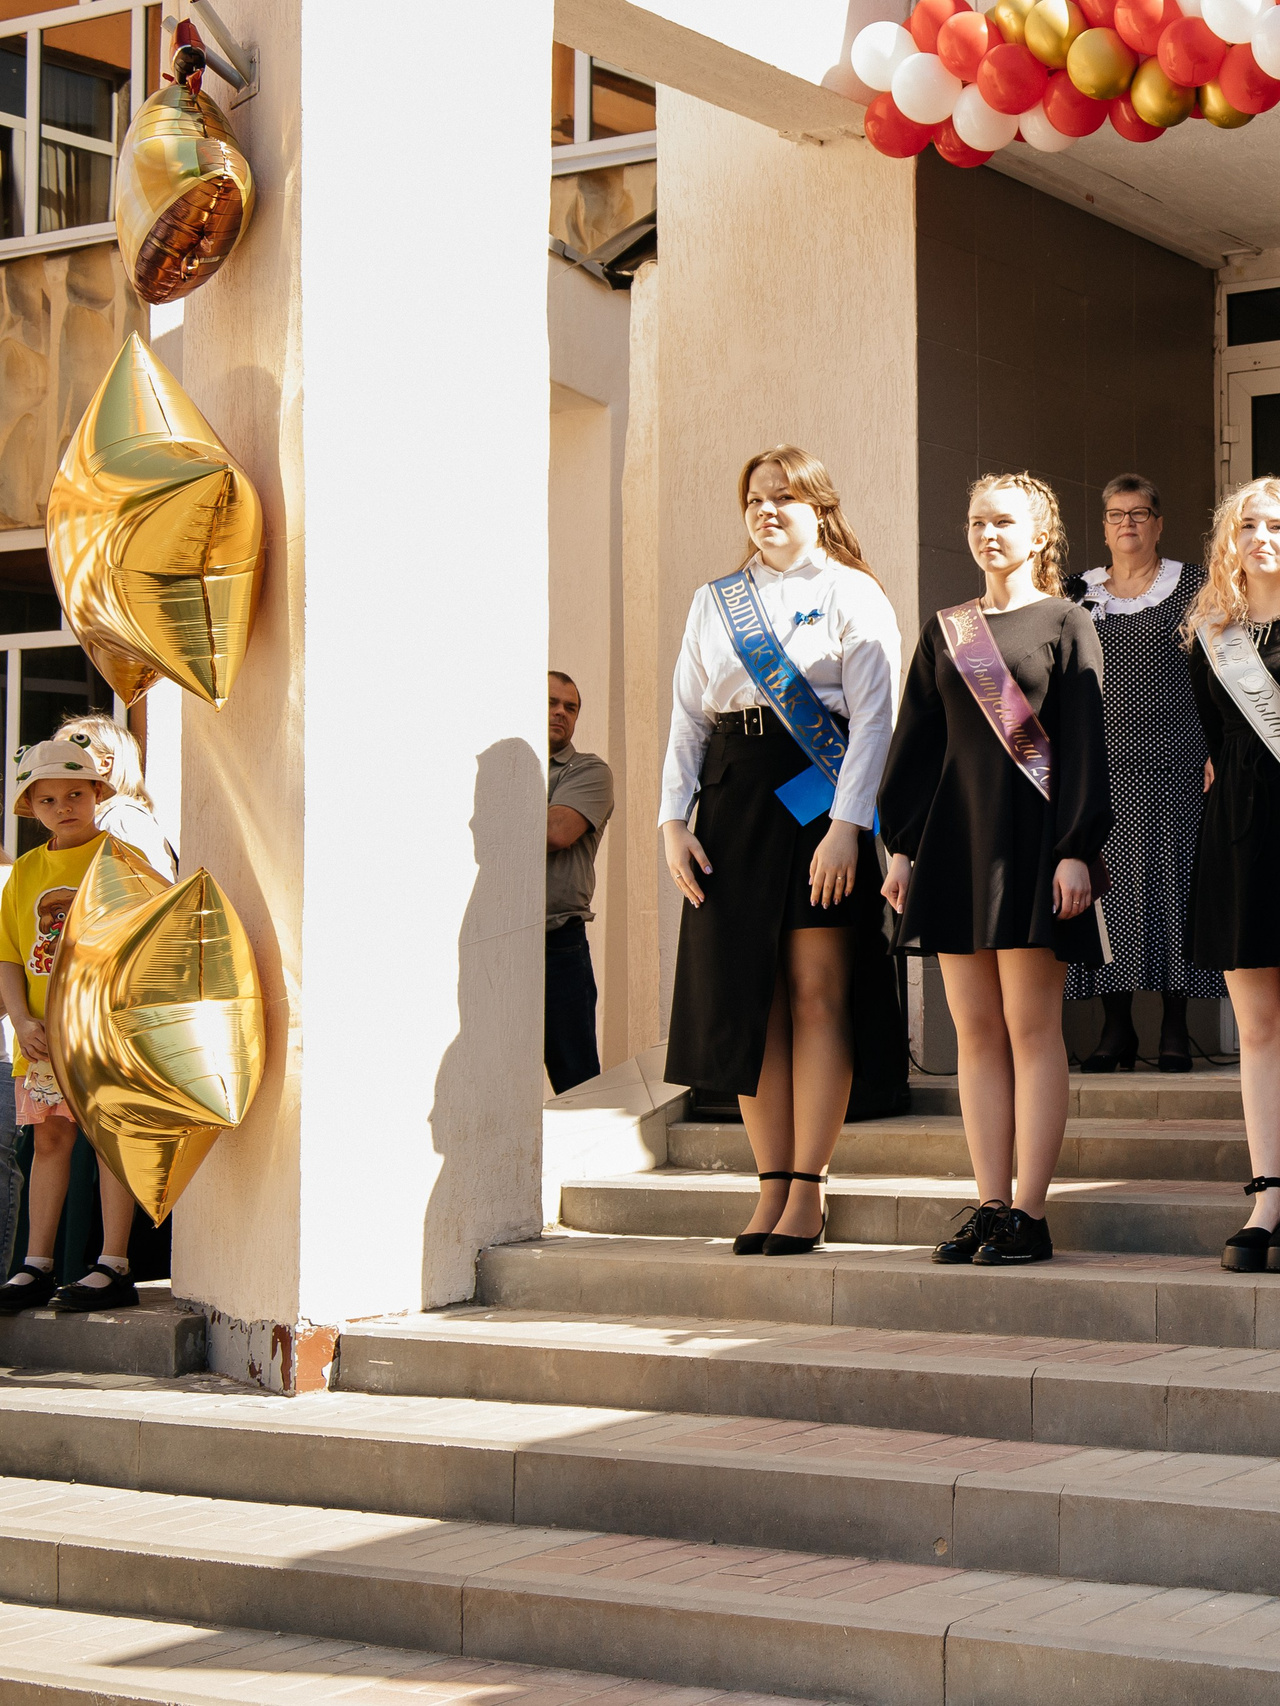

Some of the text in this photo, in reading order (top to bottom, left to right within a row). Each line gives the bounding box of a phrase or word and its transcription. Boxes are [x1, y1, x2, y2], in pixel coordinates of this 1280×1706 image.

[721, 579, 845, 778] ВЫПУСКНИК 202
[963, 641, 1042, 762] Выпускница
